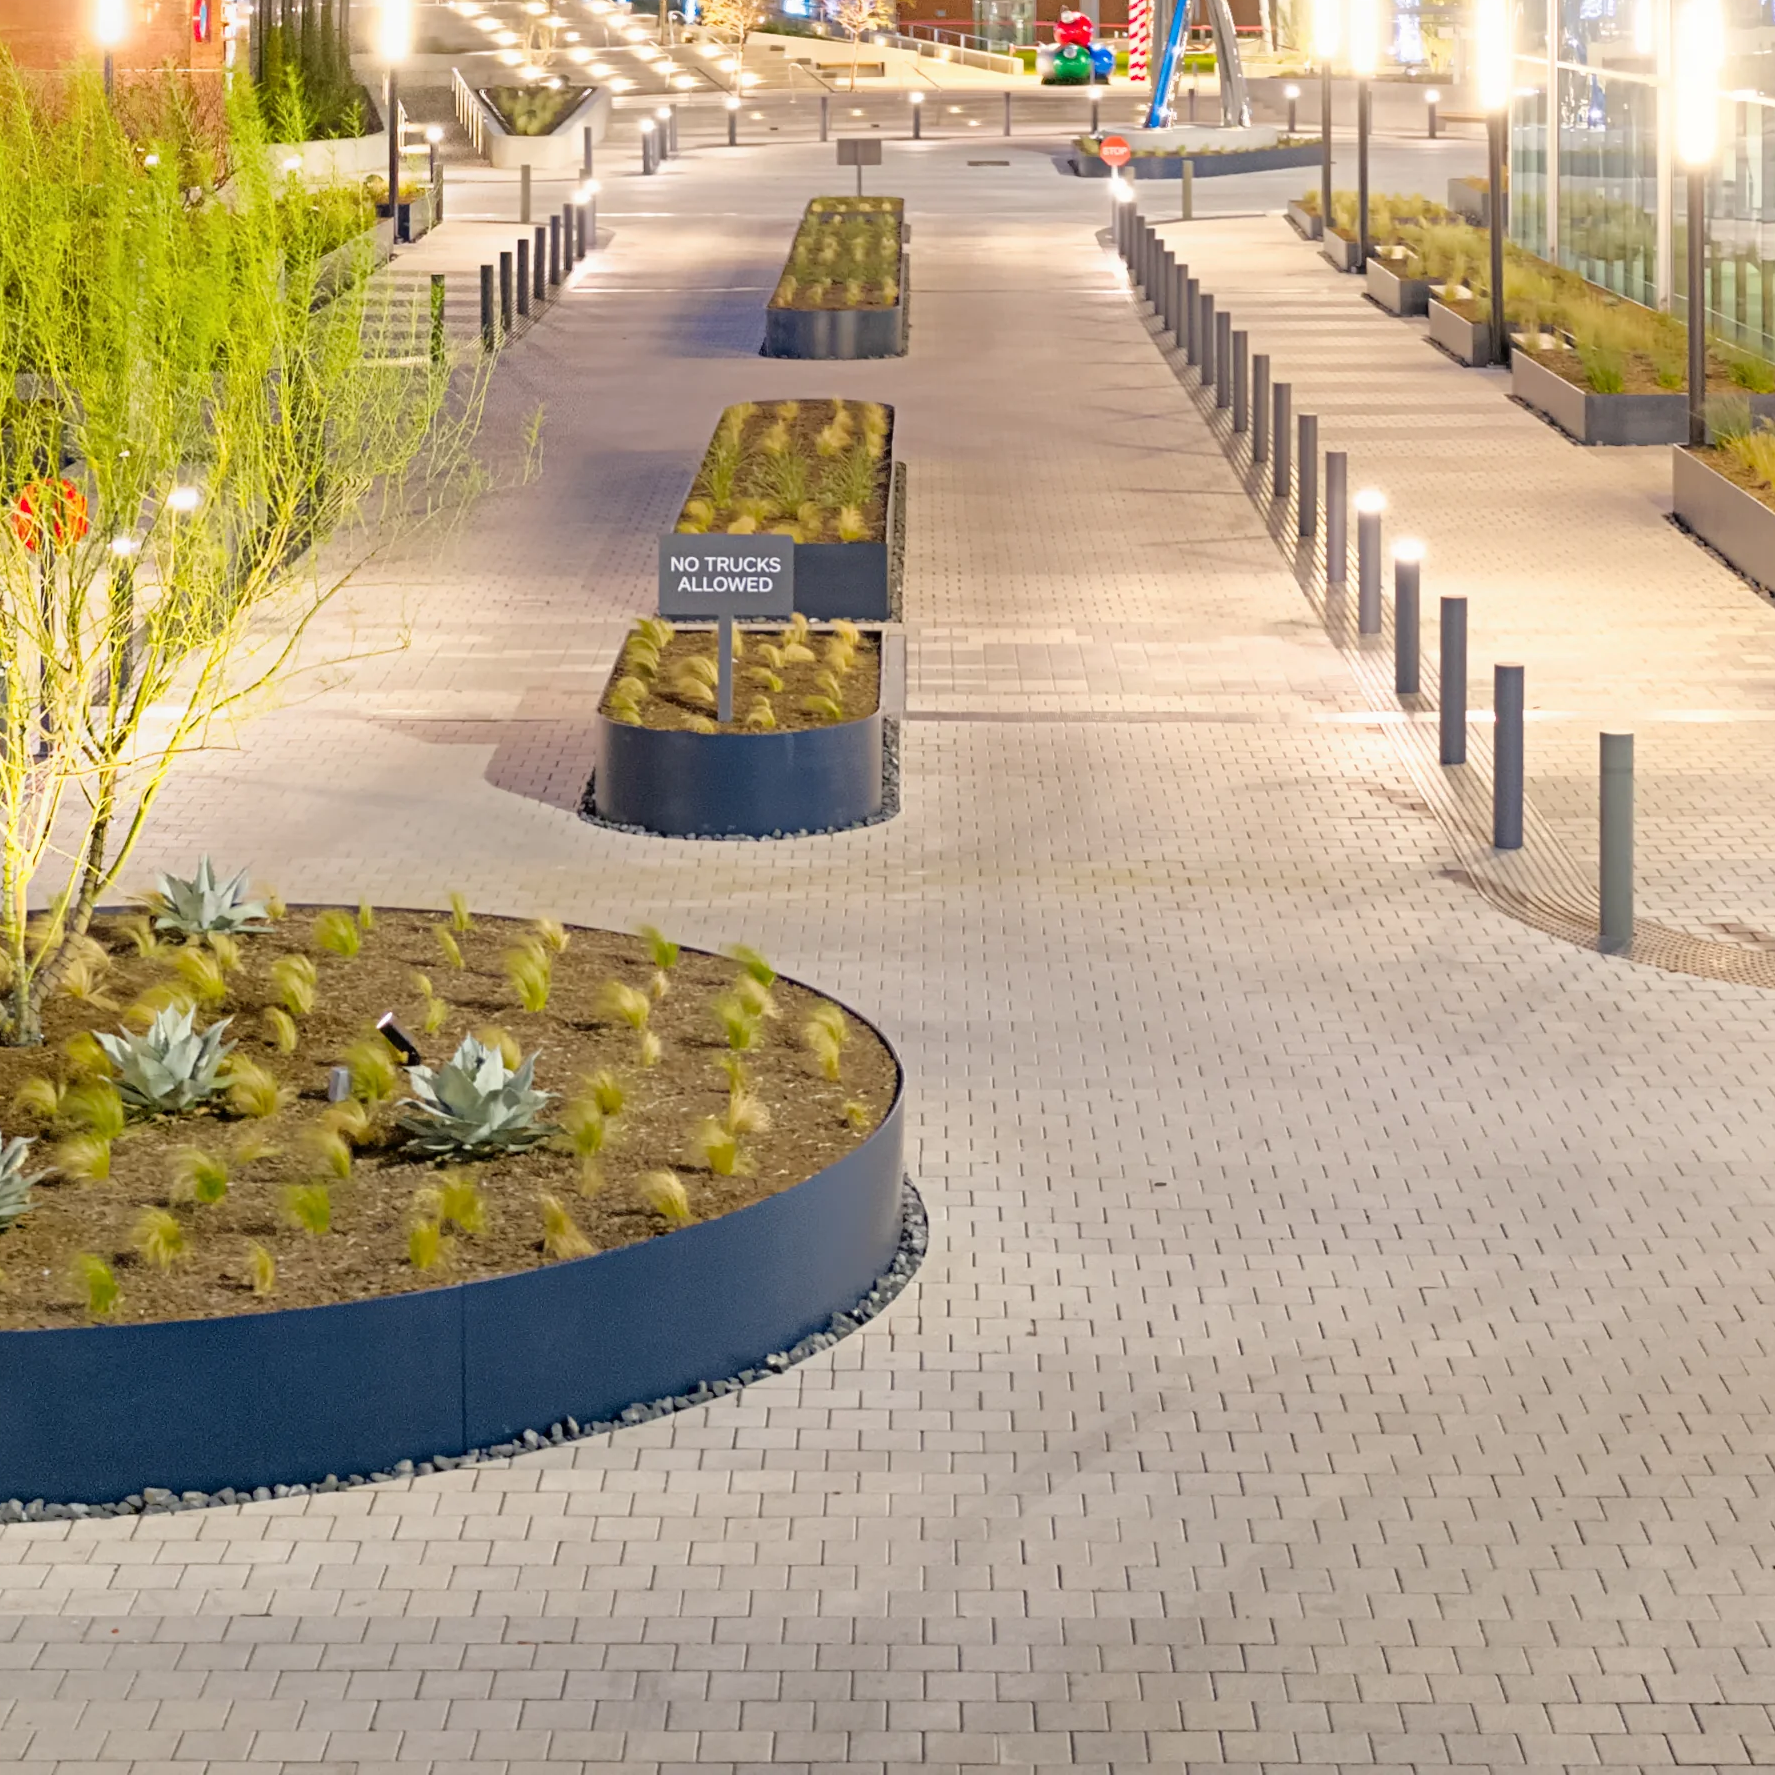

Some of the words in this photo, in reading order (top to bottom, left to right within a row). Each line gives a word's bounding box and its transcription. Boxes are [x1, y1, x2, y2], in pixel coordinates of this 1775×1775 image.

[1102, 146, 1128, 156] STOP
[670, 556, 700, 572] NO
[704, 556, 781, 572] TRUCKS
[677, 576, 773, 592] ALLOWED
